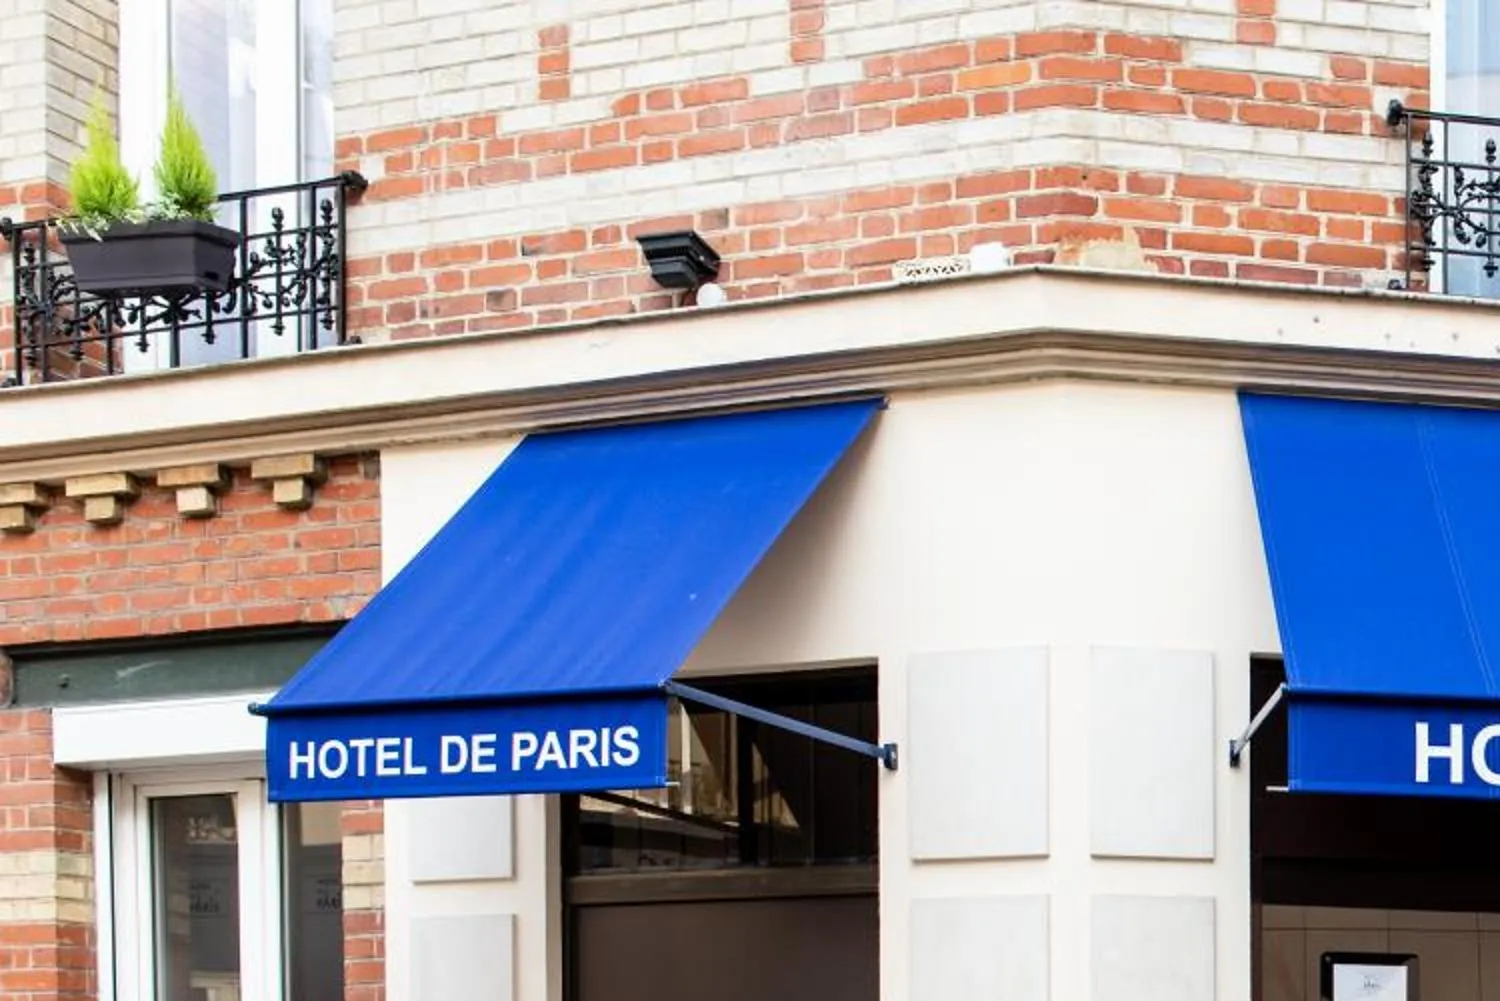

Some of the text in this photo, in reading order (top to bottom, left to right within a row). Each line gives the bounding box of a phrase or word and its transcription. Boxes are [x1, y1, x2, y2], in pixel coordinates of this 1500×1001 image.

[288, 725, 641, 779] HOTEL DE PARIS
